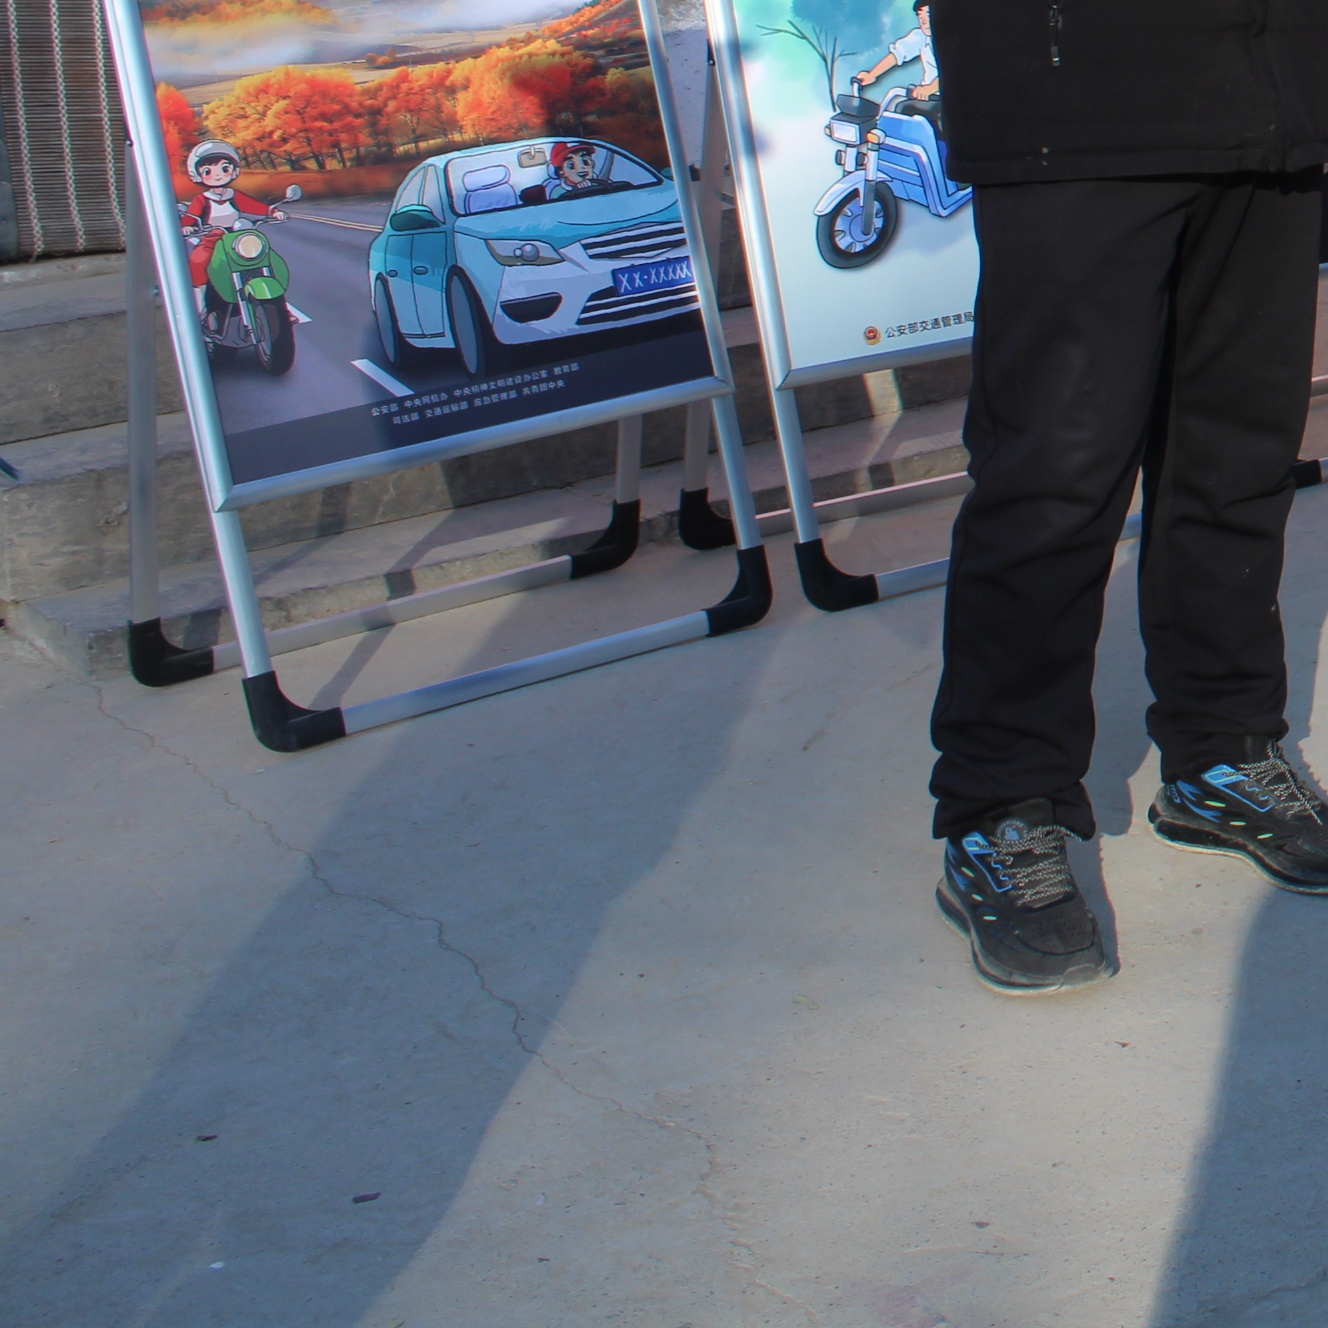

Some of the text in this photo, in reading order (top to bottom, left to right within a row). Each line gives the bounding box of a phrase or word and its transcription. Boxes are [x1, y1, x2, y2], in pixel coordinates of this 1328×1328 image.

[371, 402, 400, 417] 公安部
[453, 369, 548, 397] 中央精神文明建设办公室
[553, 362, 580, 376] 教育部
[392, 378, 565, 425] 司法部 交通运输部 应急管理部 共青团中央
